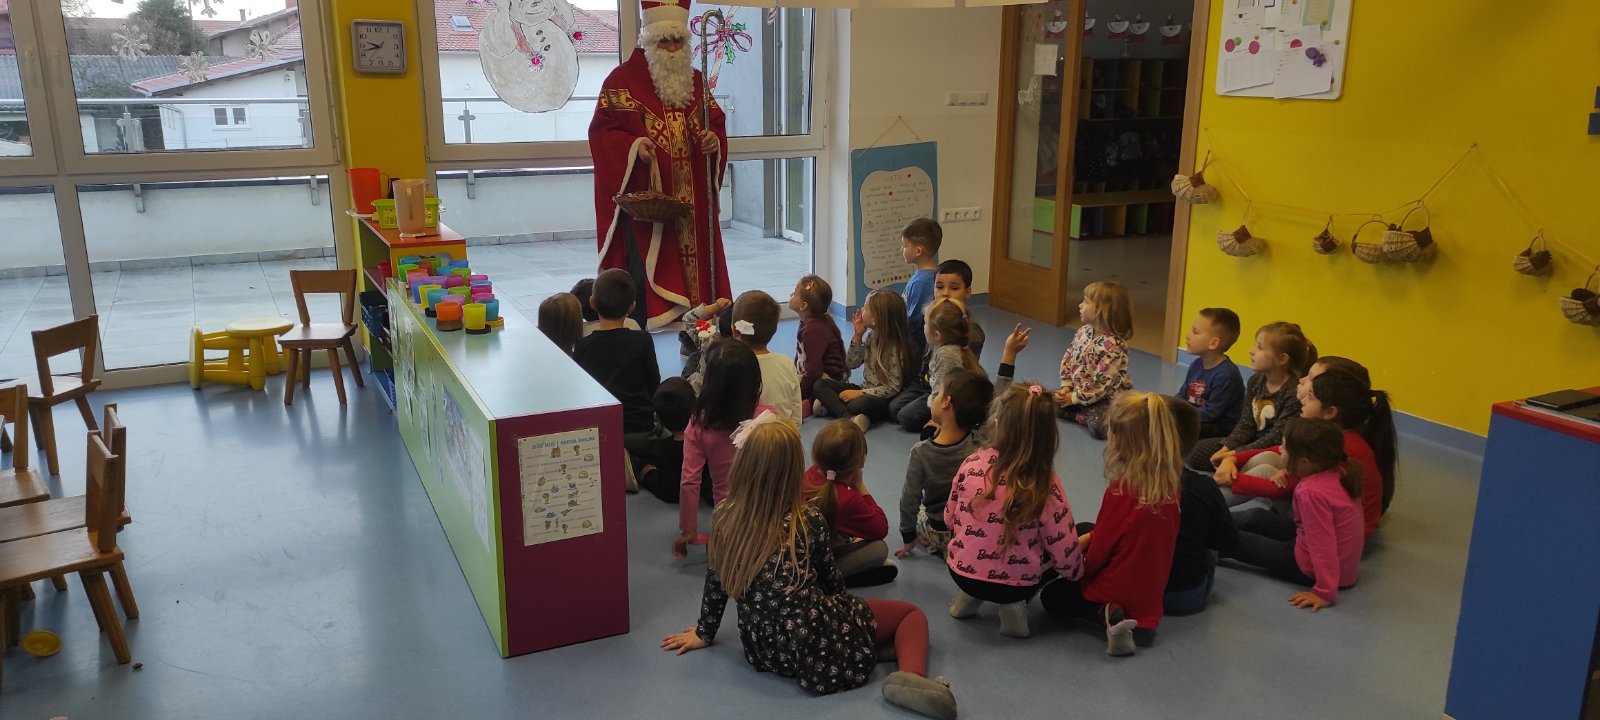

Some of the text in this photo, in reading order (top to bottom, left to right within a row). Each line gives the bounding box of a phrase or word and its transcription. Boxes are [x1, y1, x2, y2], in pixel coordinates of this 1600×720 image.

[987, 512, 1005, 524] Bar
[965, 525, 987, 538] Barbie
[1045, 532, 1066, 545] Barbie
[1007, 555, 1030, 565] Barbie
[956, 561, 977, 574] Barbie
[987, 570, 1010, 580] Barbie
